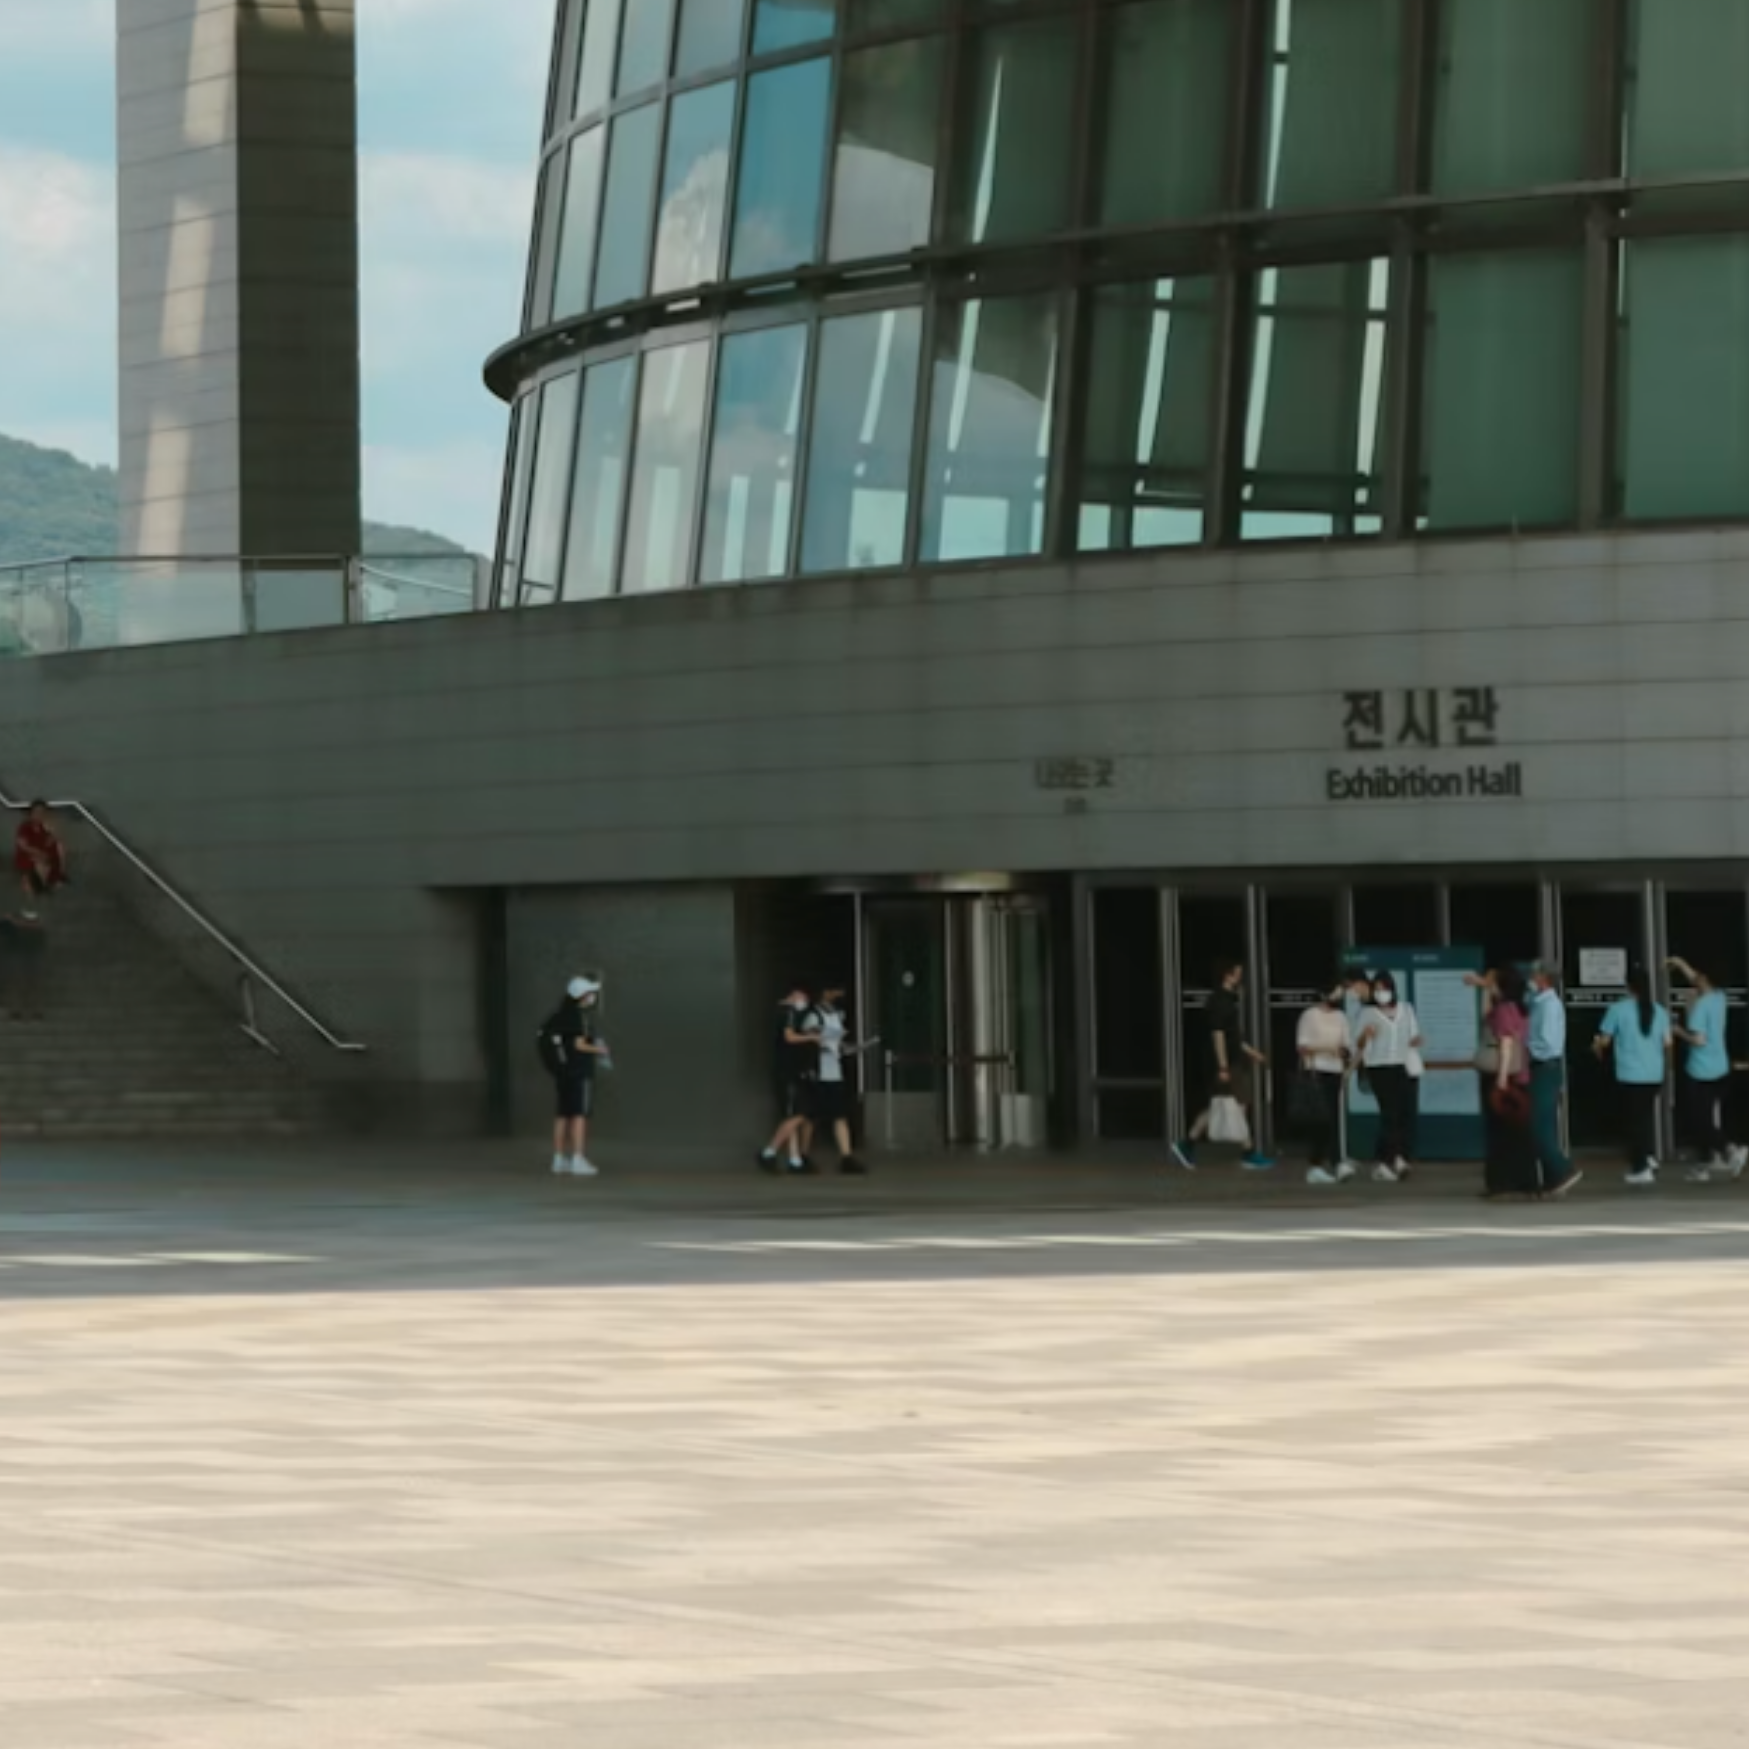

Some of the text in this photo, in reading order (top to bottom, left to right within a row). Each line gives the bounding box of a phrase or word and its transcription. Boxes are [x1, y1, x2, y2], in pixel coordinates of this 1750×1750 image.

[1343, 686, 1500, 750] 전시관
[1326, 761, 1522, 800] Exhibition Hall
